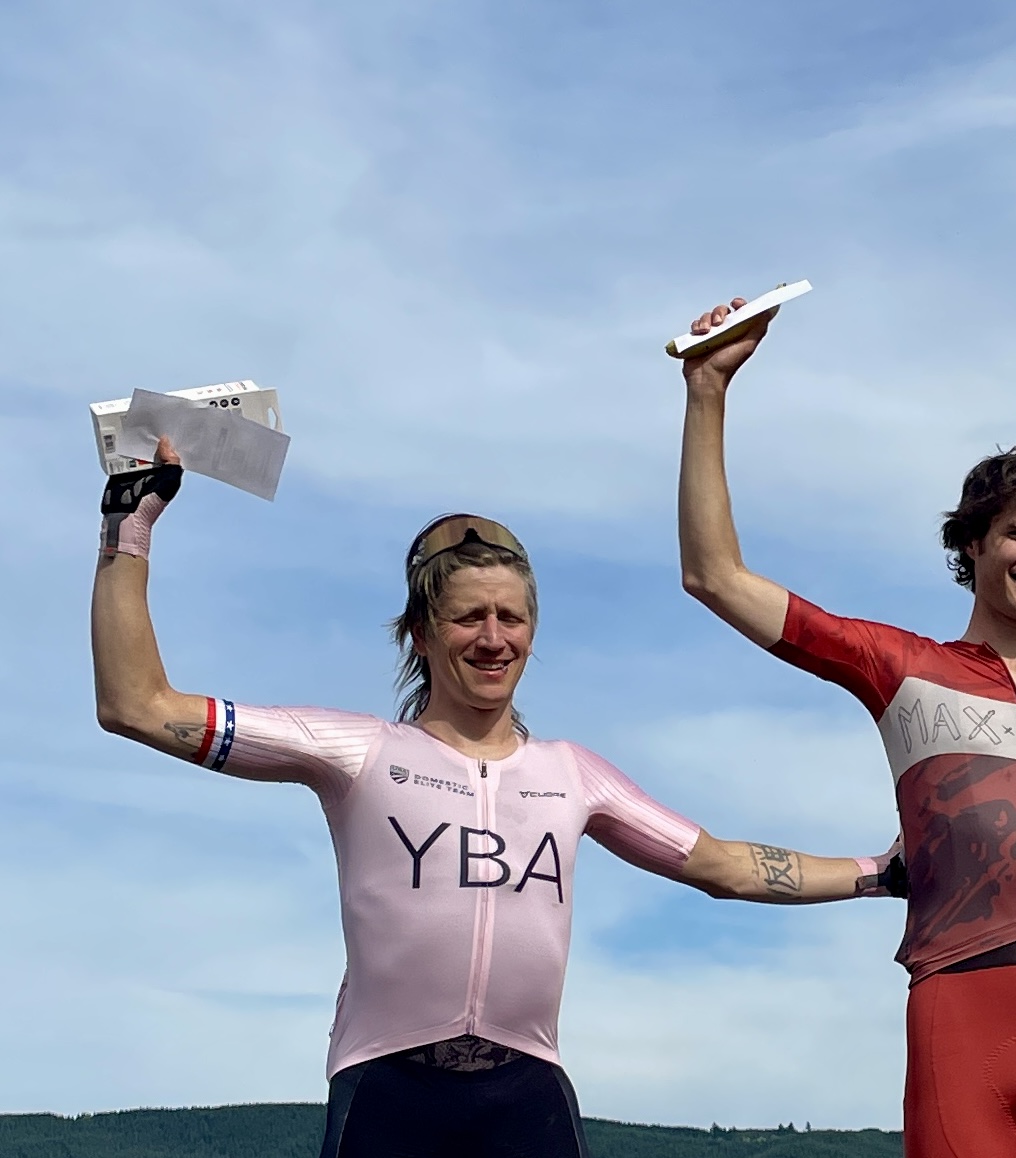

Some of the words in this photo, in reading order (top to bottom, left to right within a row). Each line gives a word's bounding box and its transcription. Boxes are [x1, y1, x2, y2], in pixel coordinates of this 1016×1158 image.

[898, 699, 1002, 754] MAX
[413, 779, 442, 790] ELITE
[447, 786, 475, 797] TEAM
[414, 774, 468, 791] DOMESTIC
[388, 816, 564, 904] YBA
